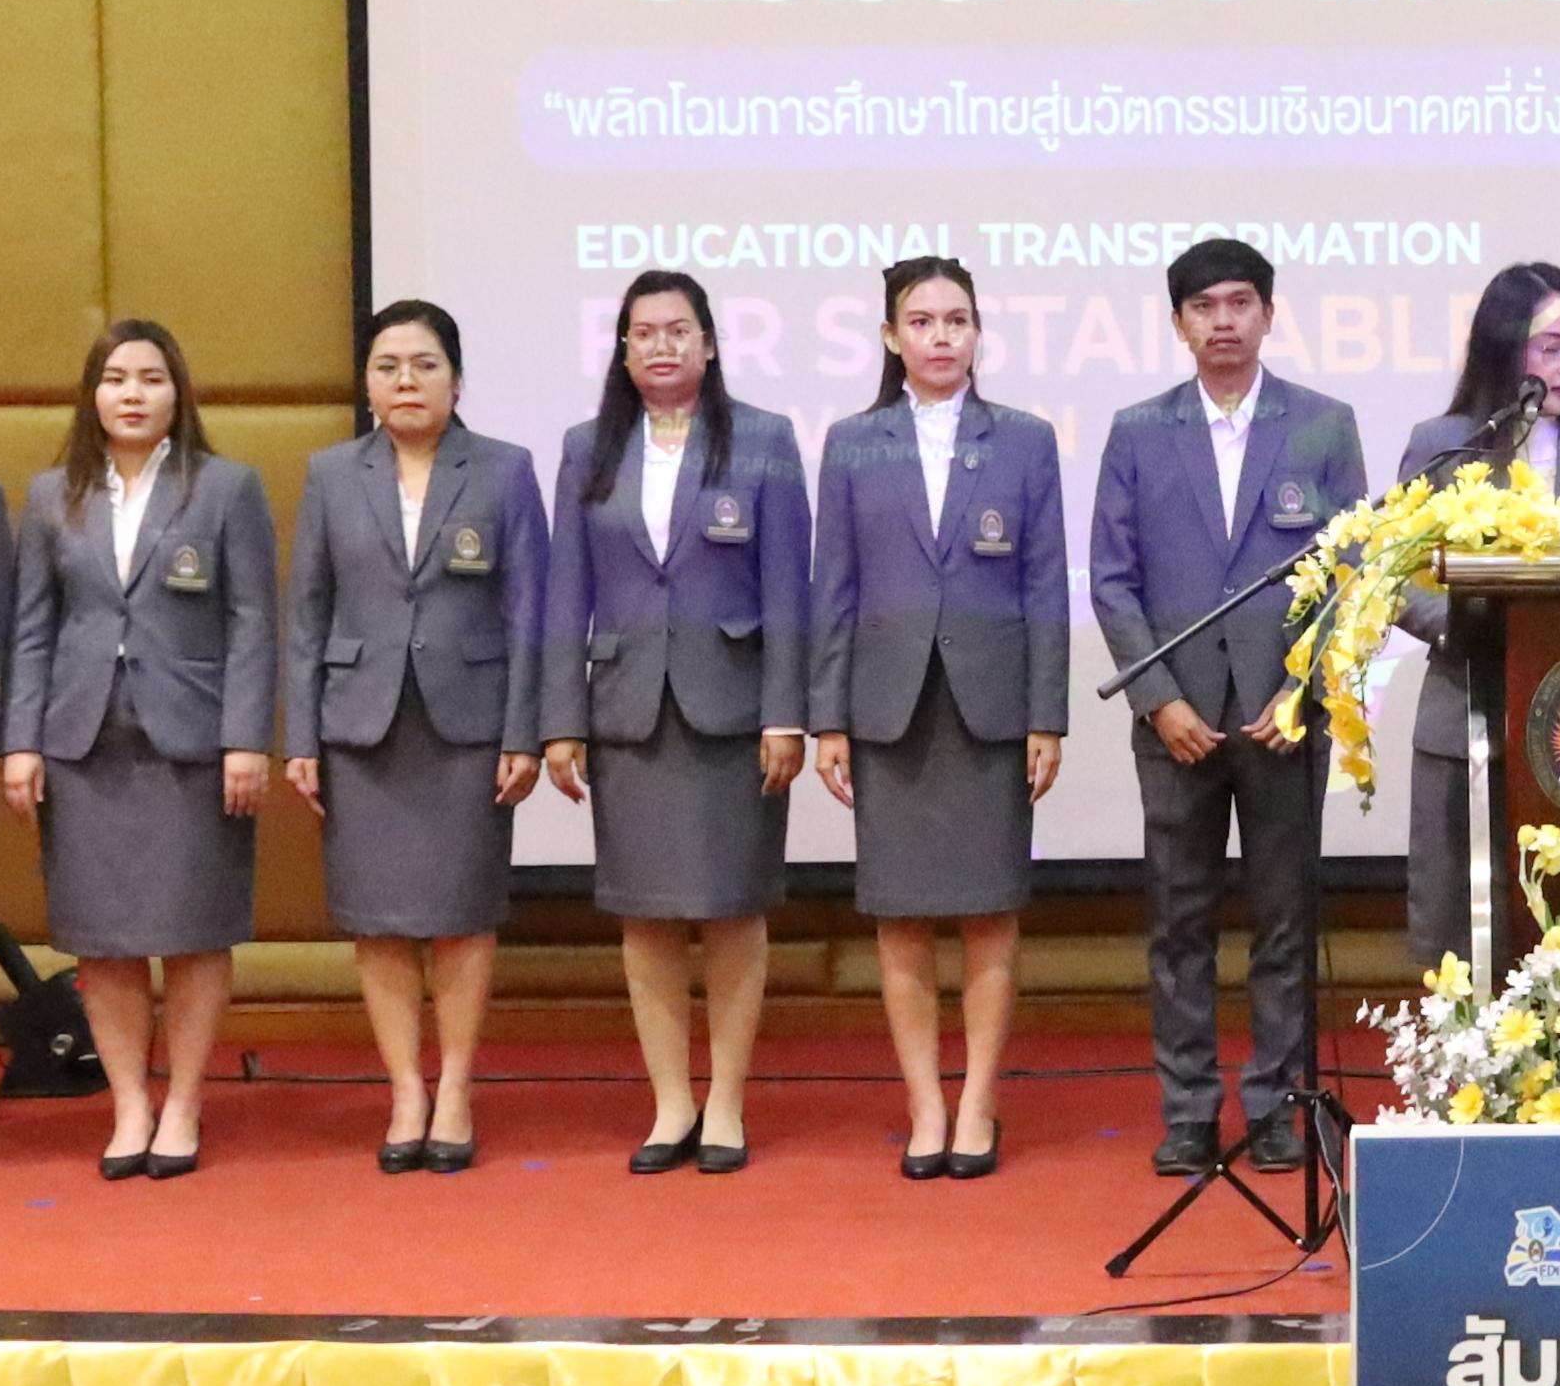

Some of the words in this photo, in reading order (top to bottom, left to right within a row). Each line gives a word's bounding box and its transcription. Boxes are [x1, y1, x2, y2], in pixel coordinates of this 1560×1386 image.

[576, 223, 967, 269] EDUCATIONAL
[979, 219, 1482, 267] TRANSFRMATION
[579, 295, 785, 378] FR
